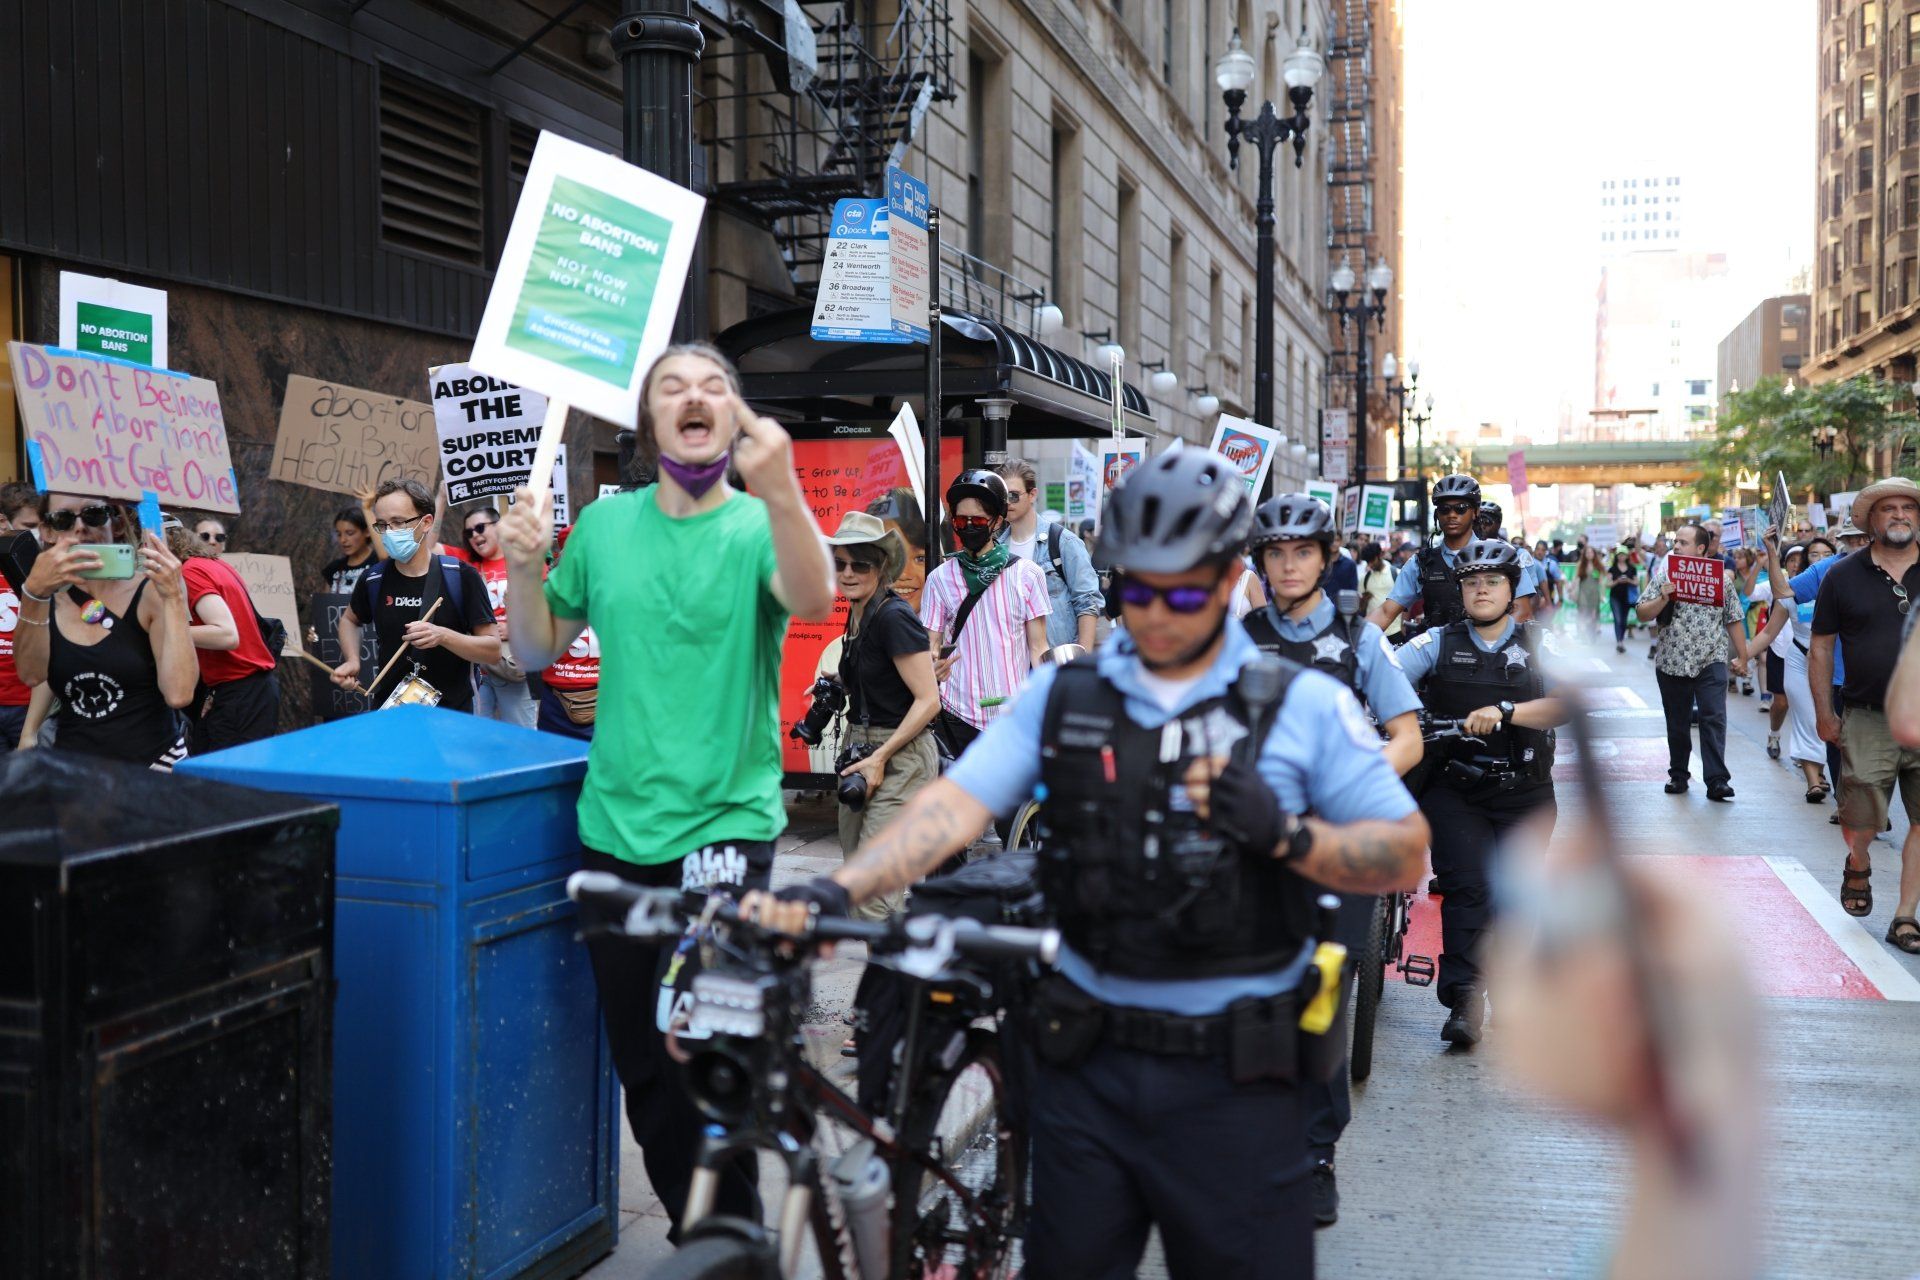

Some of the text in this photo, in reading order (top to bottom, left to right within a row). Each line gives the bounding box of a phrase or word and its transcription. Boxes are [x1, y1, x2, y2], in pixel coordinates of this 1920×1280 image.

[915, 186, 925, 205] bus
[915, 205, 927, 225] stop
[552, 203, 659, 255] NO ABORTION
[580, 231, 623, 258] BANS
[558, 256, 628, 290] NOT NOW
[549, 270, 627, 307] NOT EVER!
[842, 284, 874, 292] Broadway
[81, 324, 148, 343] NO ABORTION
[101, 340, 128, 352] BANS
[20, 346, 222, 422] Don't Believe
[311, 386, 434, 432] abortion
[460, 394, 523, 423] THE
[41, 392, 225, 455] in Abortion?
[834, 426, 871, 434] JCDecaux
[35, 431, 233, 504] Don't Get One
[446, 447, 537, 476] COURT
[796, 468, 805, 478] I
[472, 479, 492, 488] PARTY
[478, 484, 516, 494] LIBERATION
[813, 486, 828, 498] to
[834, 485, 847, 497] Be
[852, 488, 861, 497] a
[1678, 559, 1713, 575] SAVE
[1672, 571, 1719, 584] MIDWESTERN
[1676, 580, 1715, 598] LIVES
